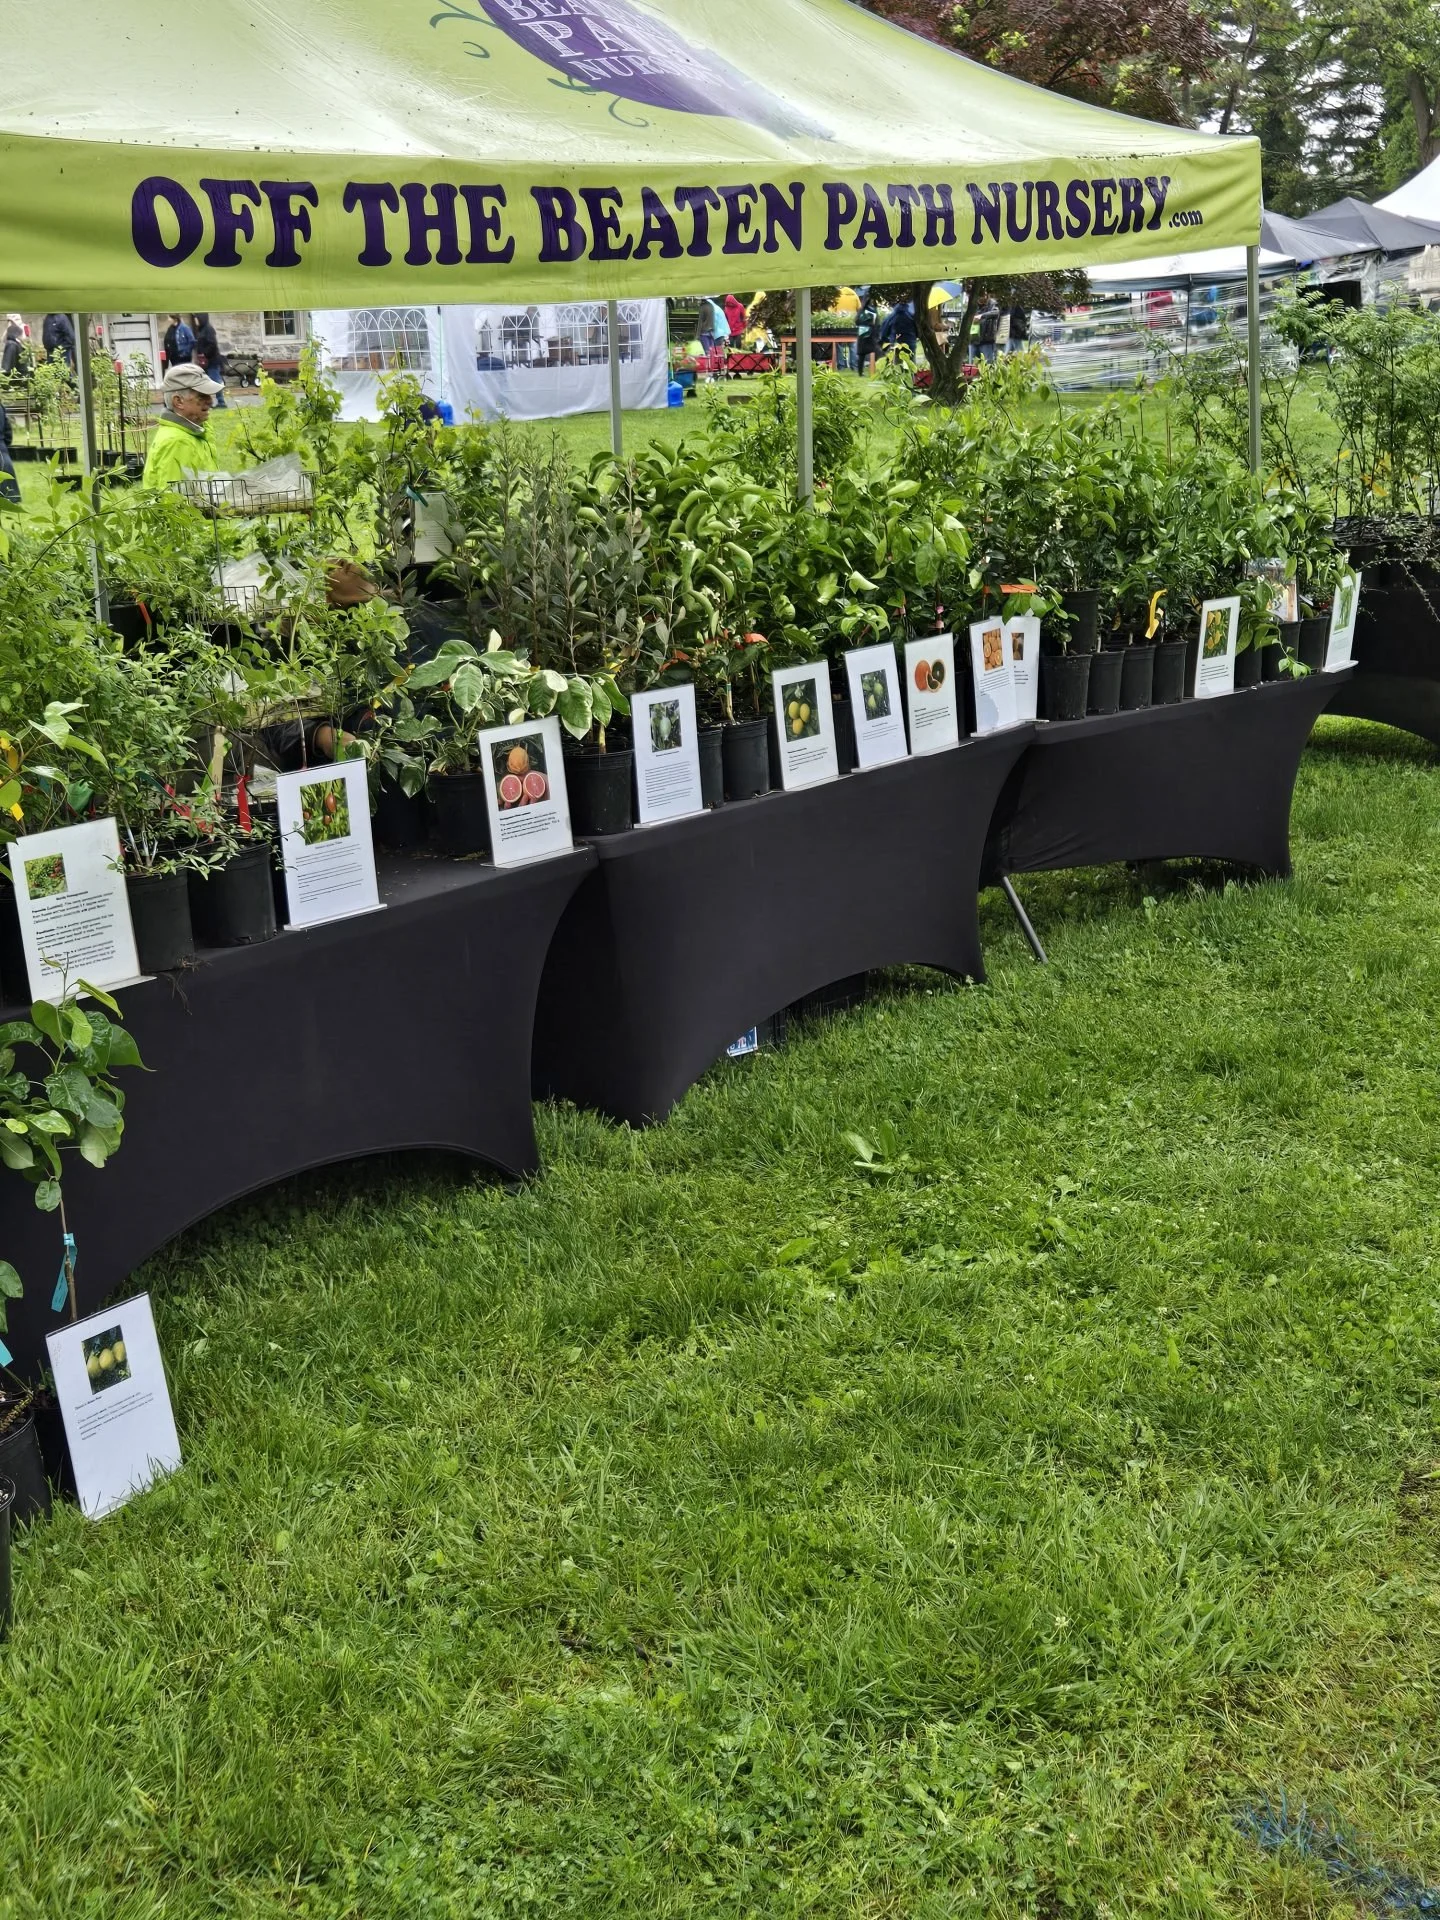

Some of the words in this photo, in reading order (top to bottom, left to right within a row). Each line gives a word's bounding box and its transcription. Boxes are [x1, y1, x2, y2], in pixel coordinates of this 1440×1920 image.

[132, 176, 318, 267] OFF
[343, 182, 514, 265] THE
[530, 182, 804, 261] BEATEN
[823, 183, 956, 249] PATH
